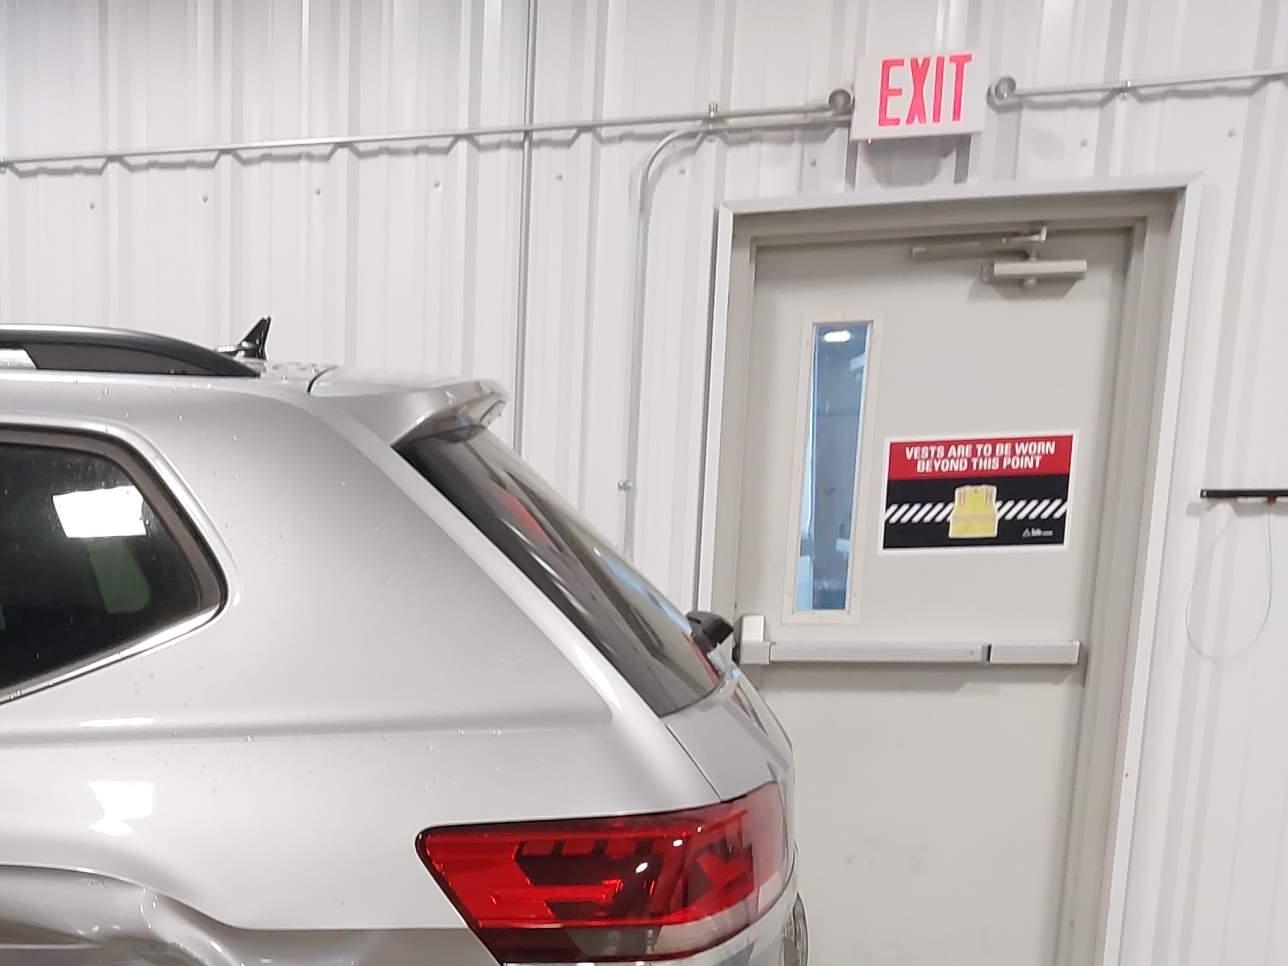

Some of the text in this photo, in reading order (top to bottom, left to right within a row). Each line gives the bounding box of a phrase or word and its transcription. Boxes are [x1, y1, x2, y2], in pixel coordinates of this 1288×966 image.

[878, 53, 973, 127] EXIT
[905, 440, 1056, 460] VESTS ARE TO BE WORN
[916, 455, 1042, 473] BEYOND THIS POINT
